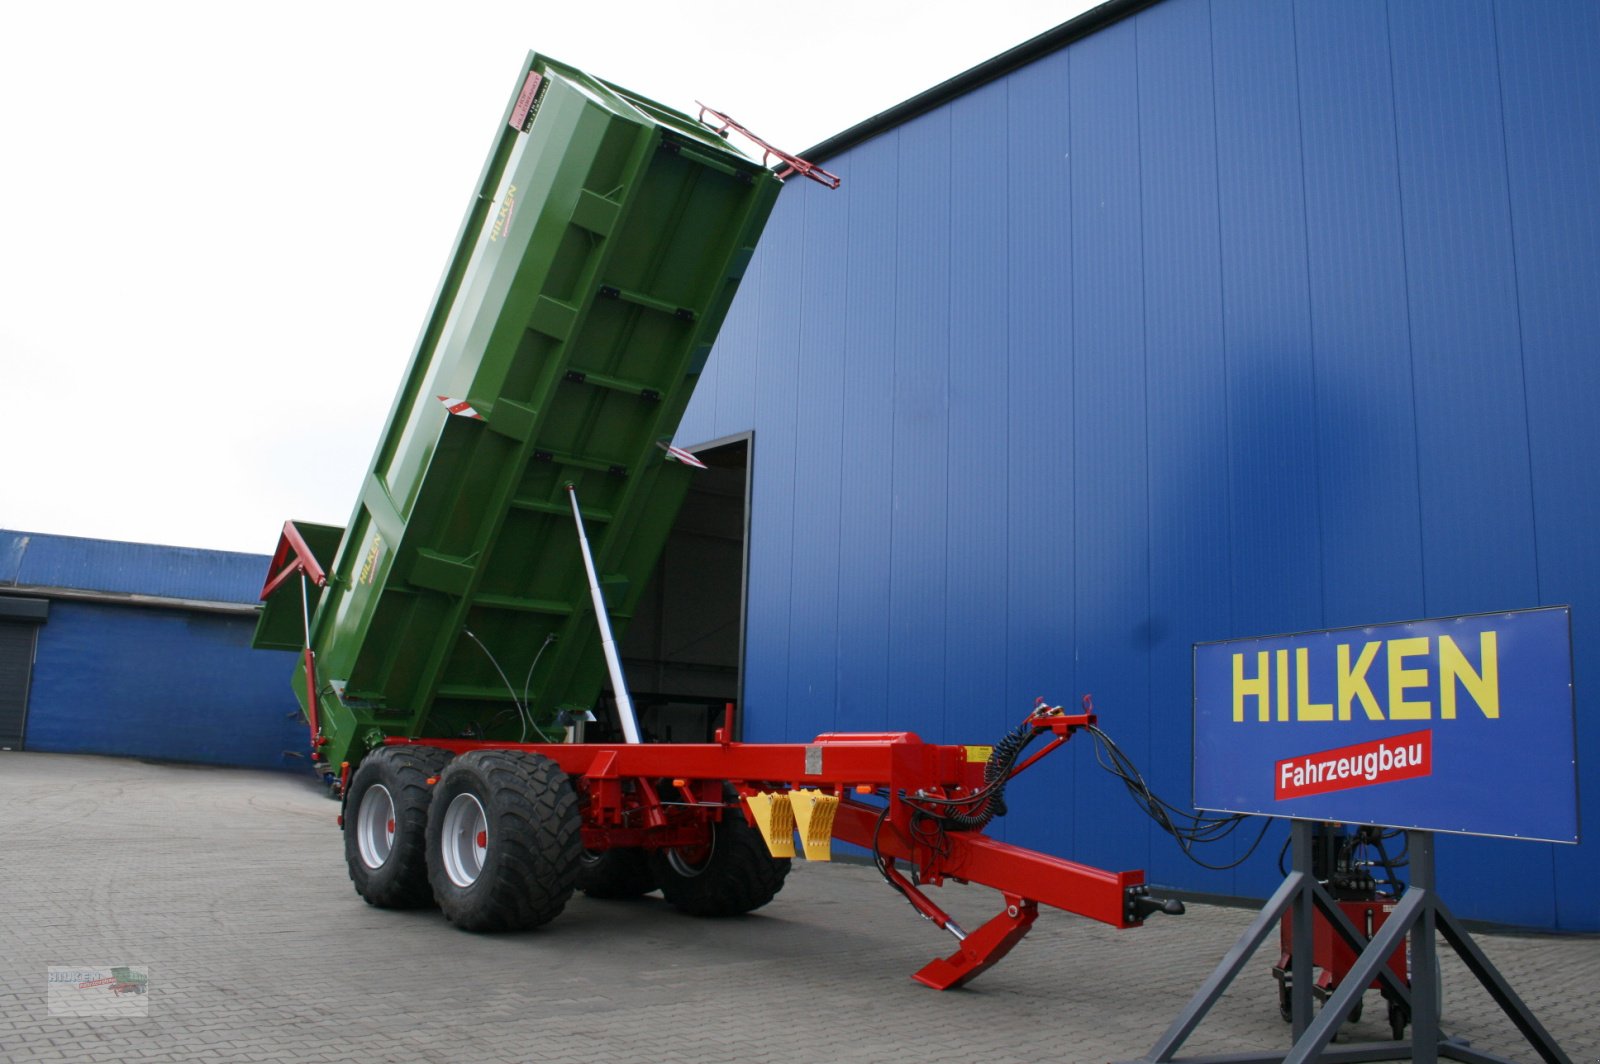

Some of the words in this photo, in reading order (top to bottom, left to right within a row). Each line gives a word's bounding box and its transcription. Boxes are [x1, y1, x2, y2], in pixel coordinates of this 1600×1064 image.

[491, 185, 517, 241] HILKEN
[360, 533, 381, 584] HILKEN
[1233, 631, 1499, 722] HILKEN
[1281, 743, 1422, 789] Fahrzeugbau
